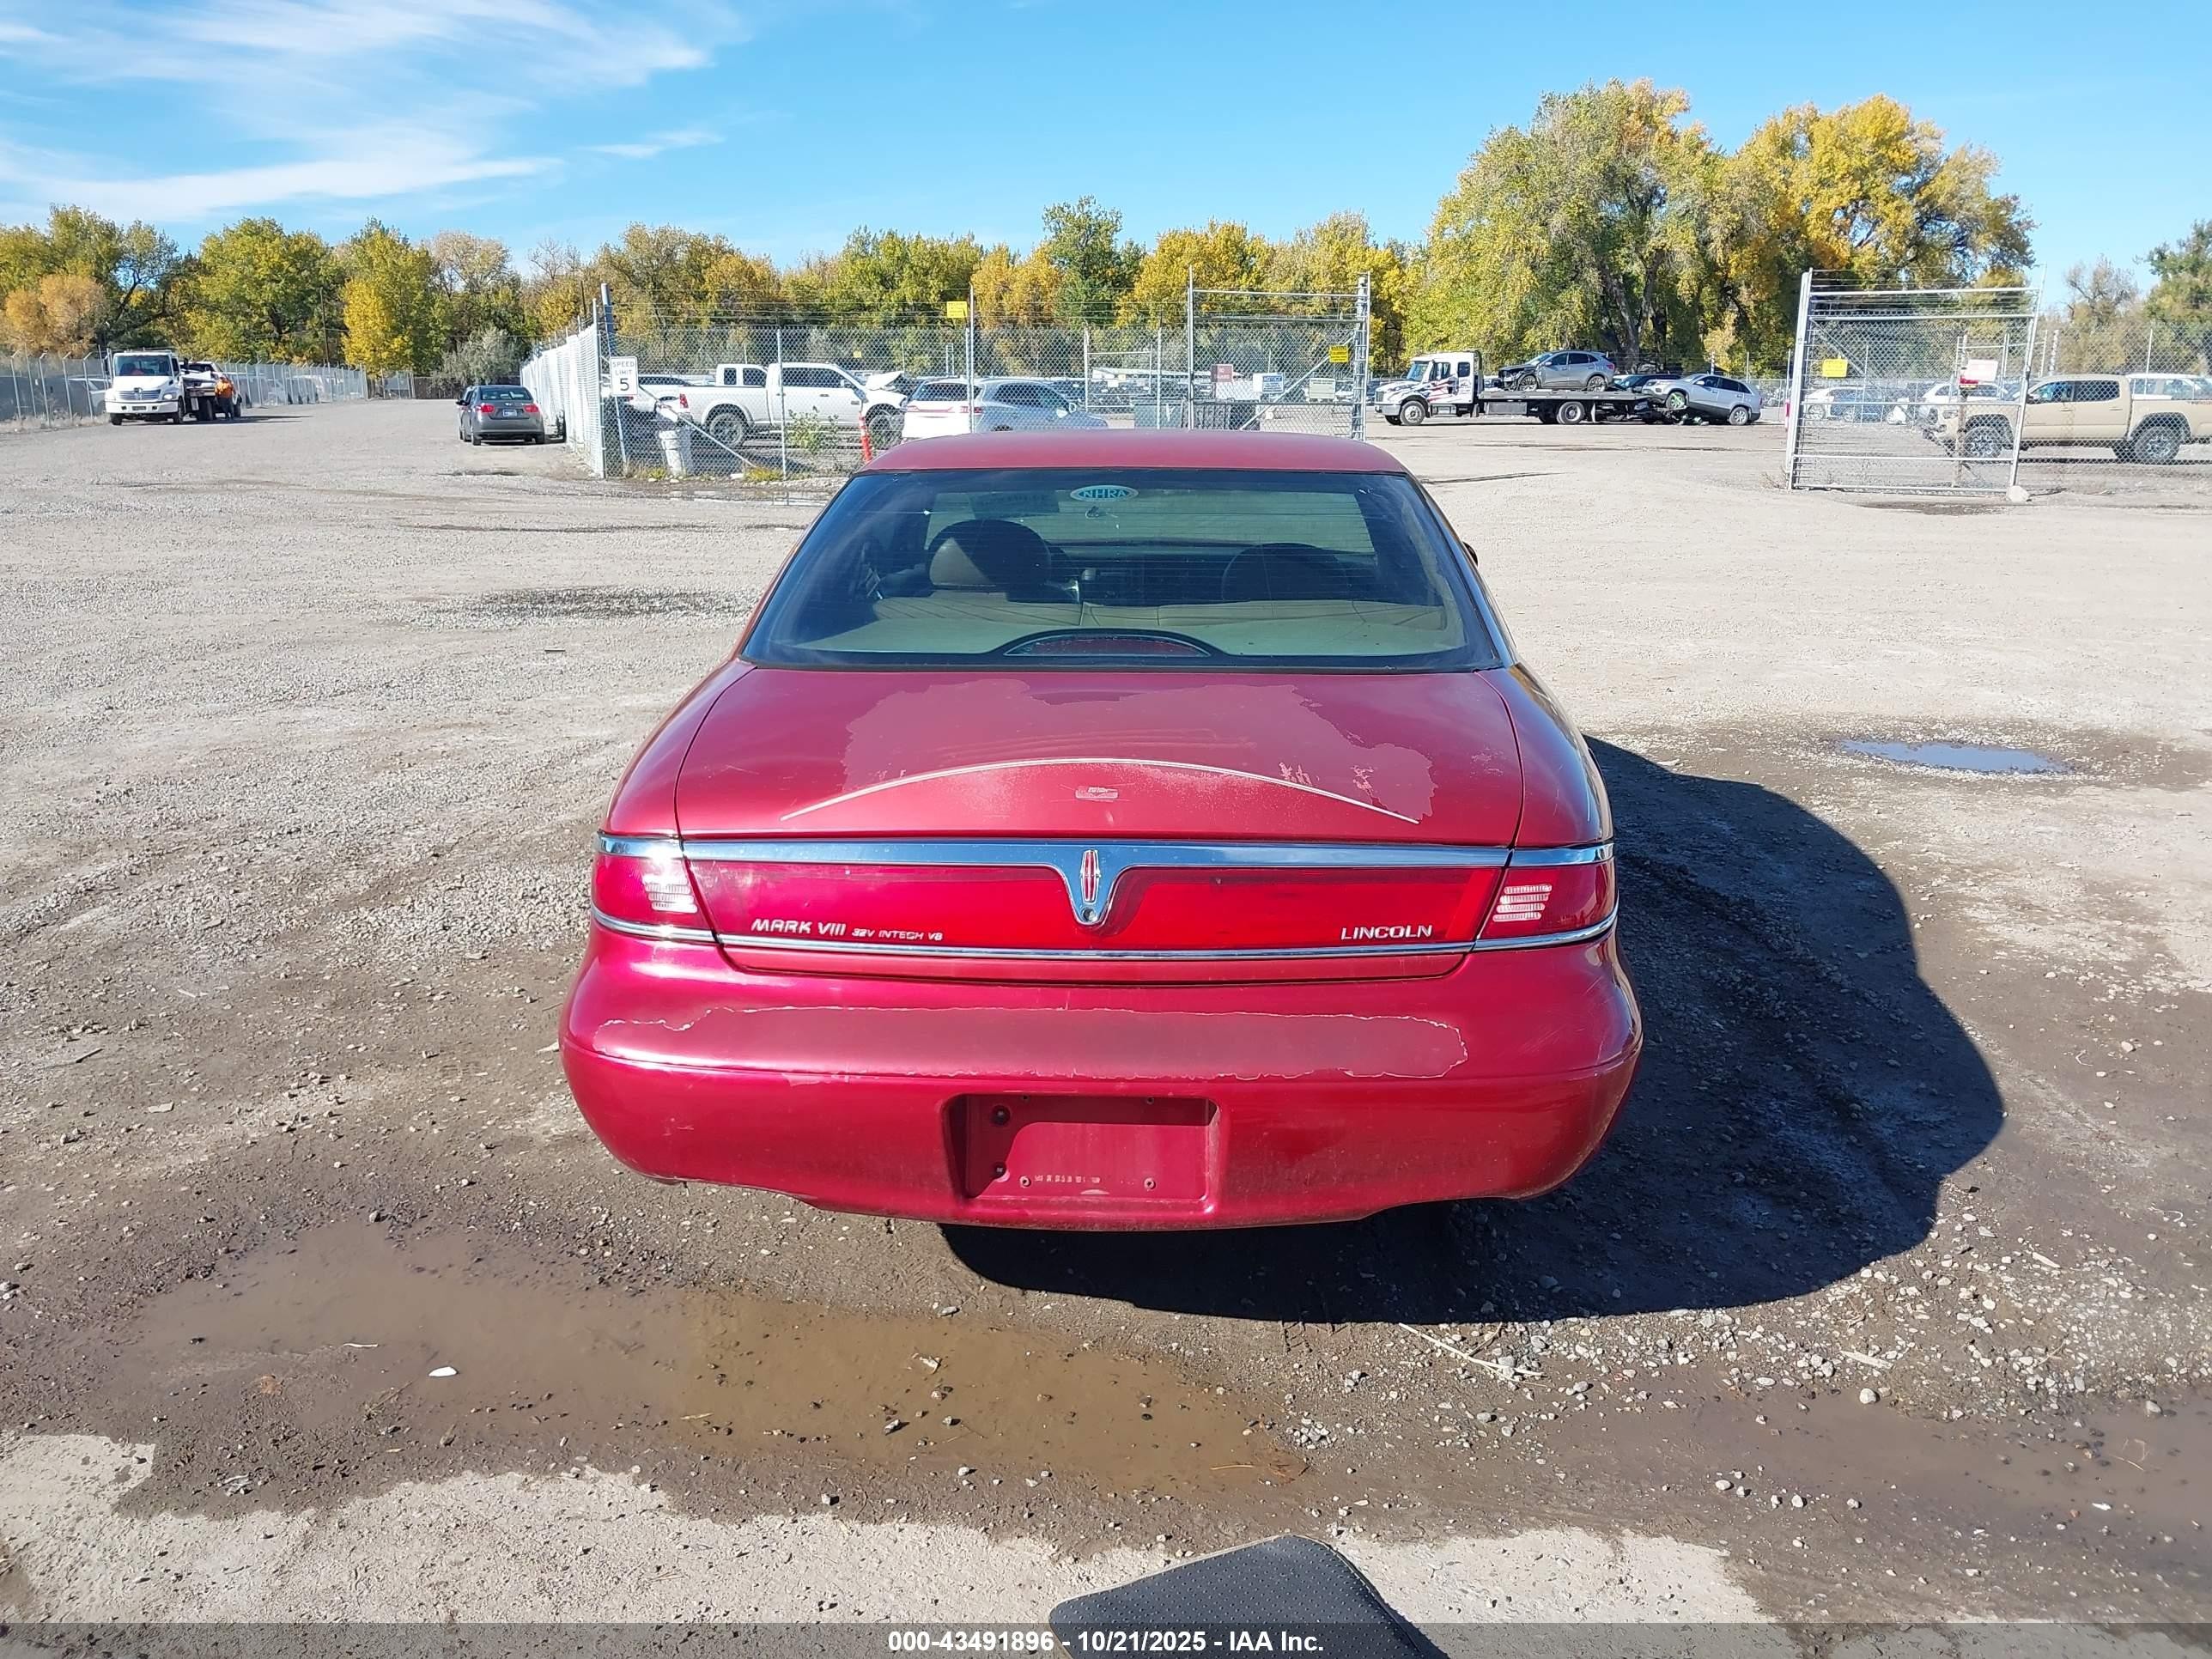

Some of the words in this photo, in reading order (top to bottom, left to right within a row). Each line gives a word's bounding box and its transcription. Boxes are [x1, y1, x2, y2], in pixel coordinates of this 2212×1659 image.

[620, 378, 629, 391] 5
[1082, 489, 1127, 500] NHRA
[751, 918, 813, 934] MARK
[817, 921, 847, 937] VIII
[927, 932, 944, 941] V8
[1340, 925, 1433, 940] LINCOLN
